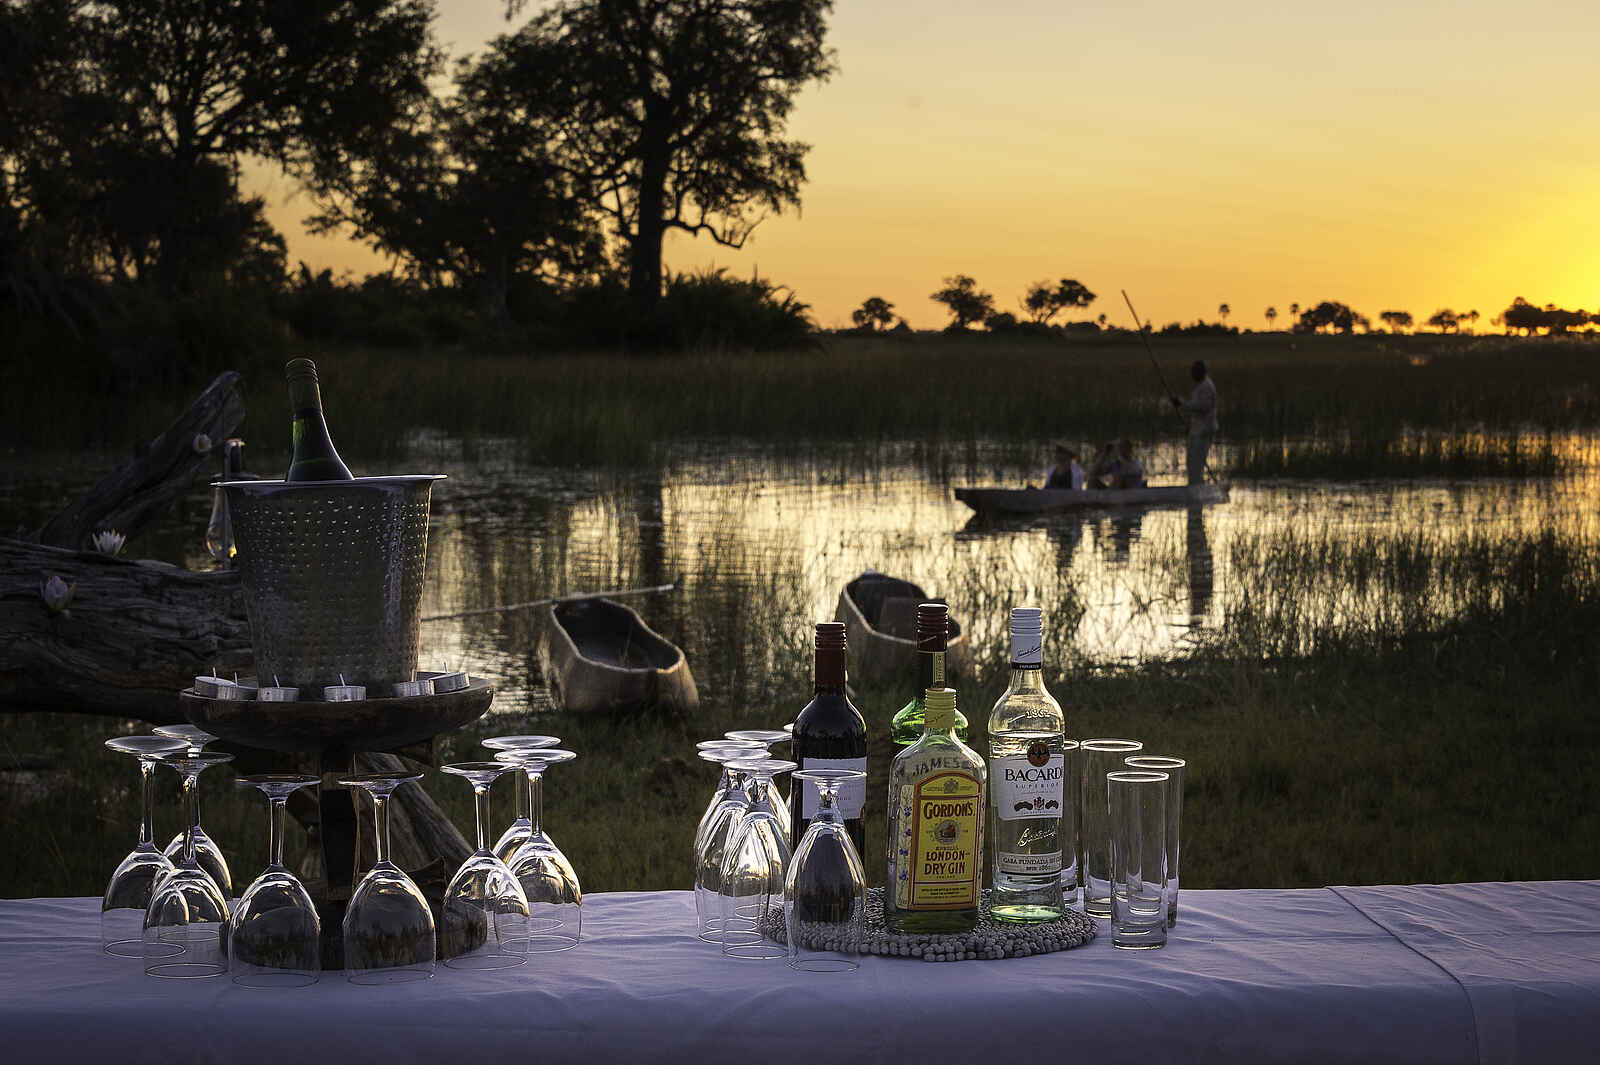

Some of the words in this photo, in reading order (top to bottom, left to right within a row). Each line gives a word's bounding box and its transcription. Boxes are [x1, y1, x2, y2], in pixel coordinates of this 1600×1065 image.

[1005, 766, 1062, 782] BACARD
[926, 850, 965, 862] LONDON
[924, 863, 946, 875] DRY
[947, 862, 965, 875] GIN
